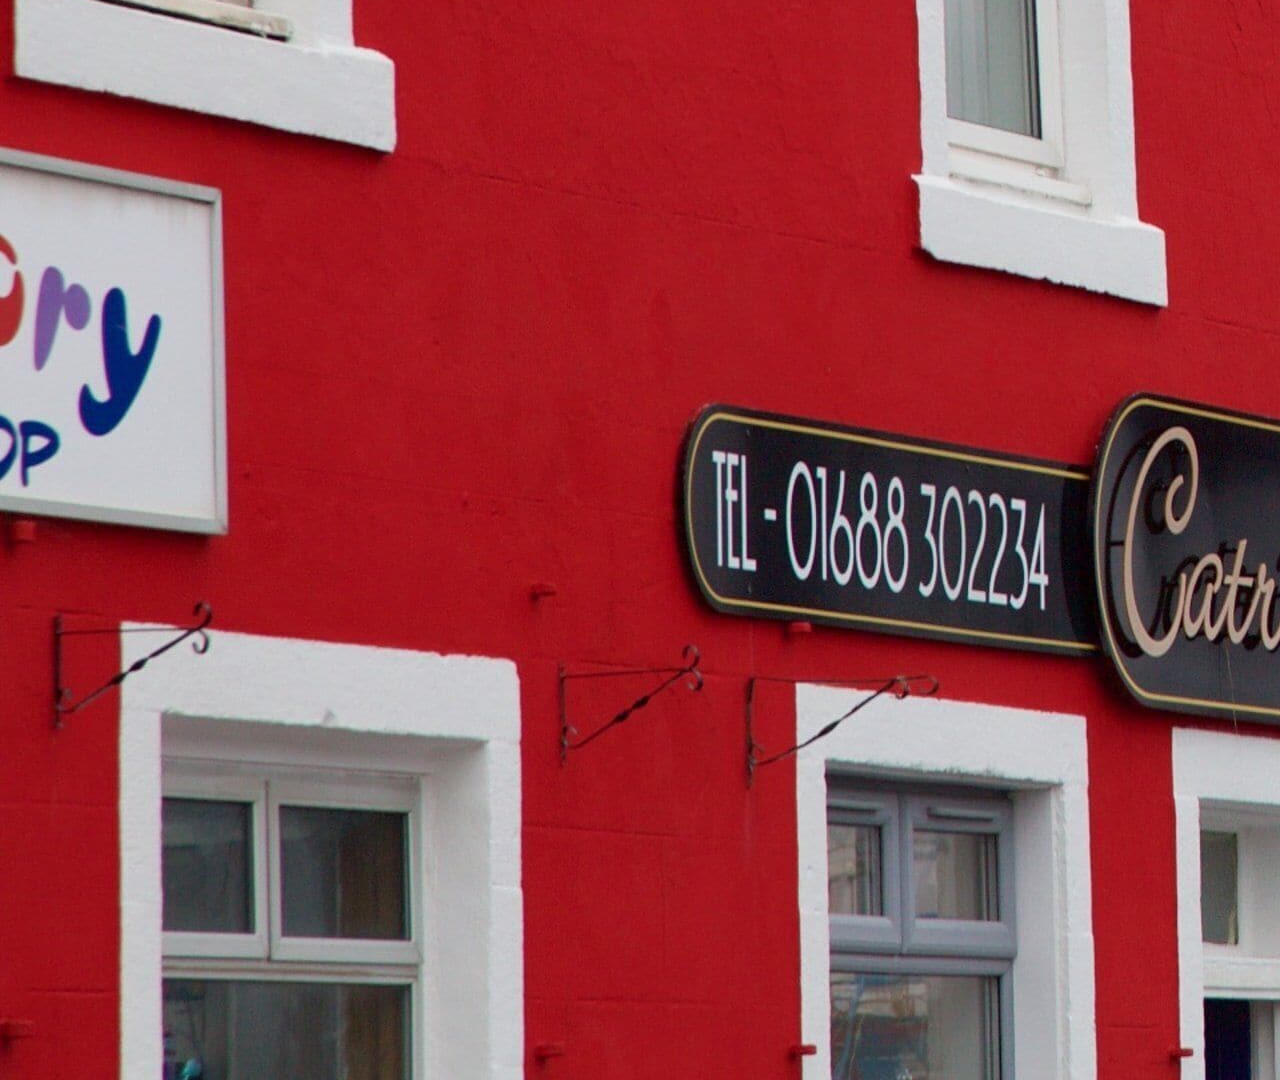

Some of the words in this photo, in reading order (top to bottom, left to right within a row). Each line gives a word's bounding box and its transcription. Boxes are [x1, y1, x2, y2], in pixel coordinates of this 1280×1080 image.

[712, 450, 757, 572] TEL
[786, 461, 910, 593] 01688
[919, 482, 1050, 612] 302234
